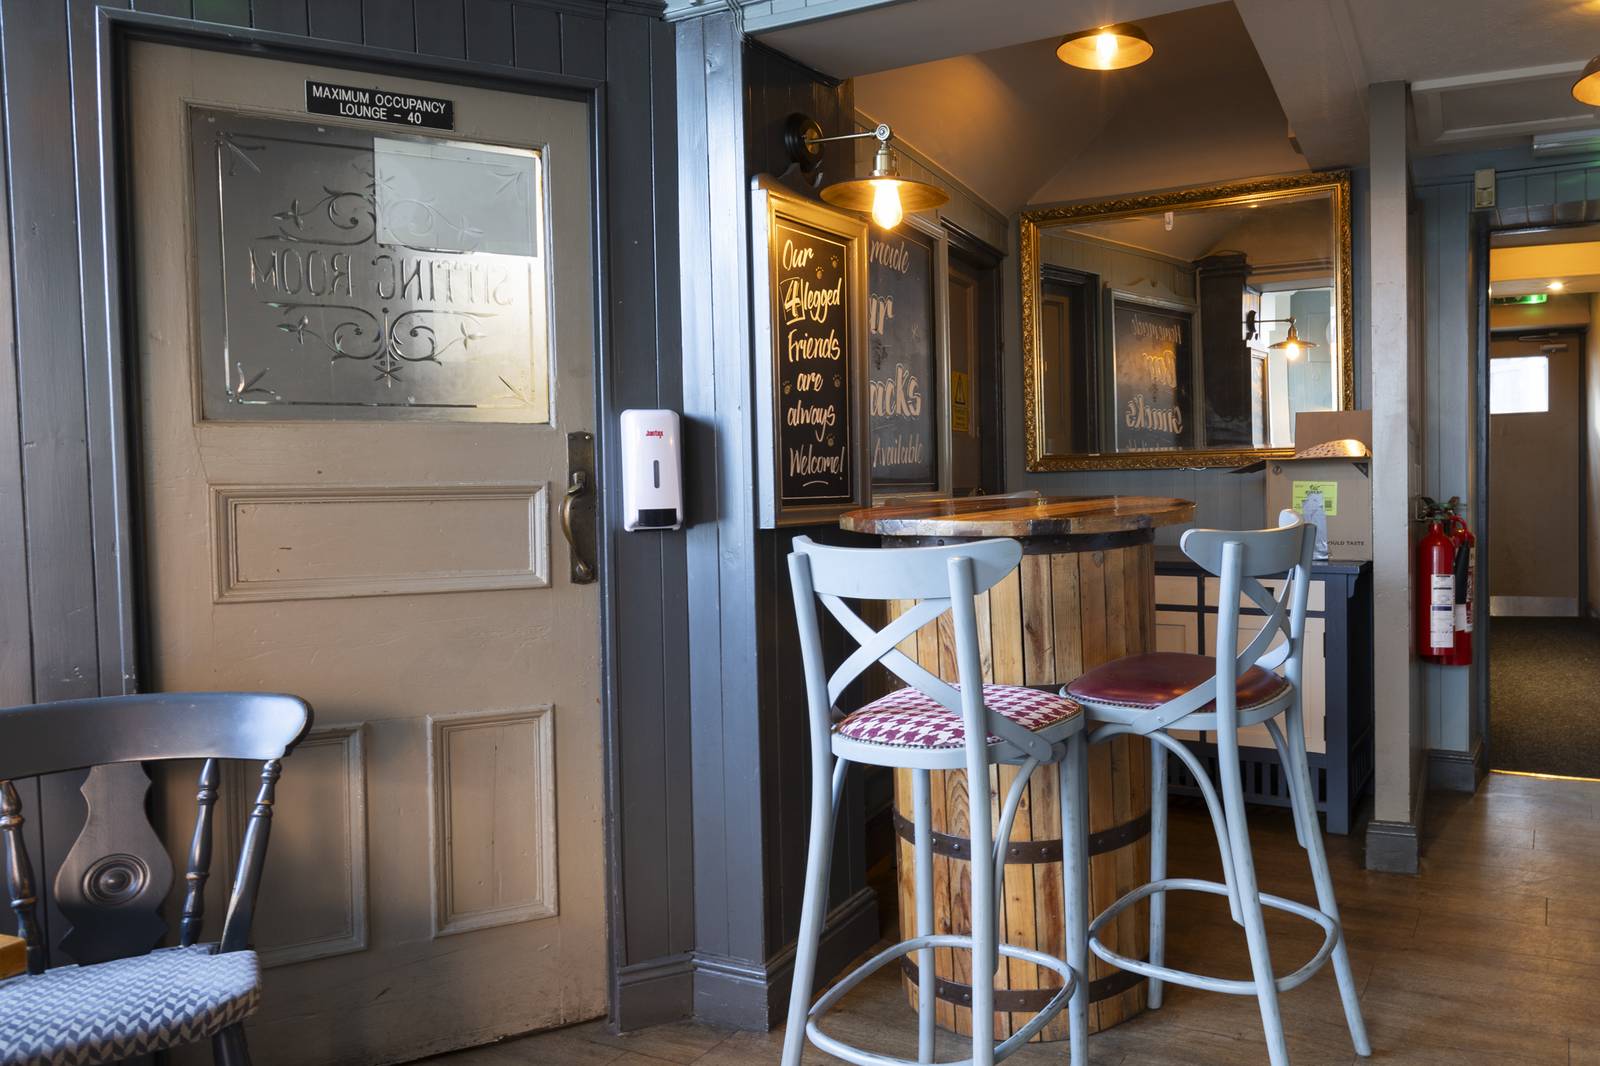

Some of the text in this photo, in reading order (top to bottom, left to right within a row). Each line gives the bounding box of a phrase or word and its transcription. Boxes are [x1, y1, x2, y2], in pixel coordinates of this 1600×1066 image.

[312, 85, 446, 114] MAXIMUM OCCUPANCY
[339, 102, 388, 120] LOUNGE
[407, 112, 422, 124] 40
[783, 239, 814, 271] Our
[787, 328, 841, 363] Friends
[797, 372, 823, 392] are
[787, 399, 836, 442] always
[789, 444, 845, 481] Welcome!
